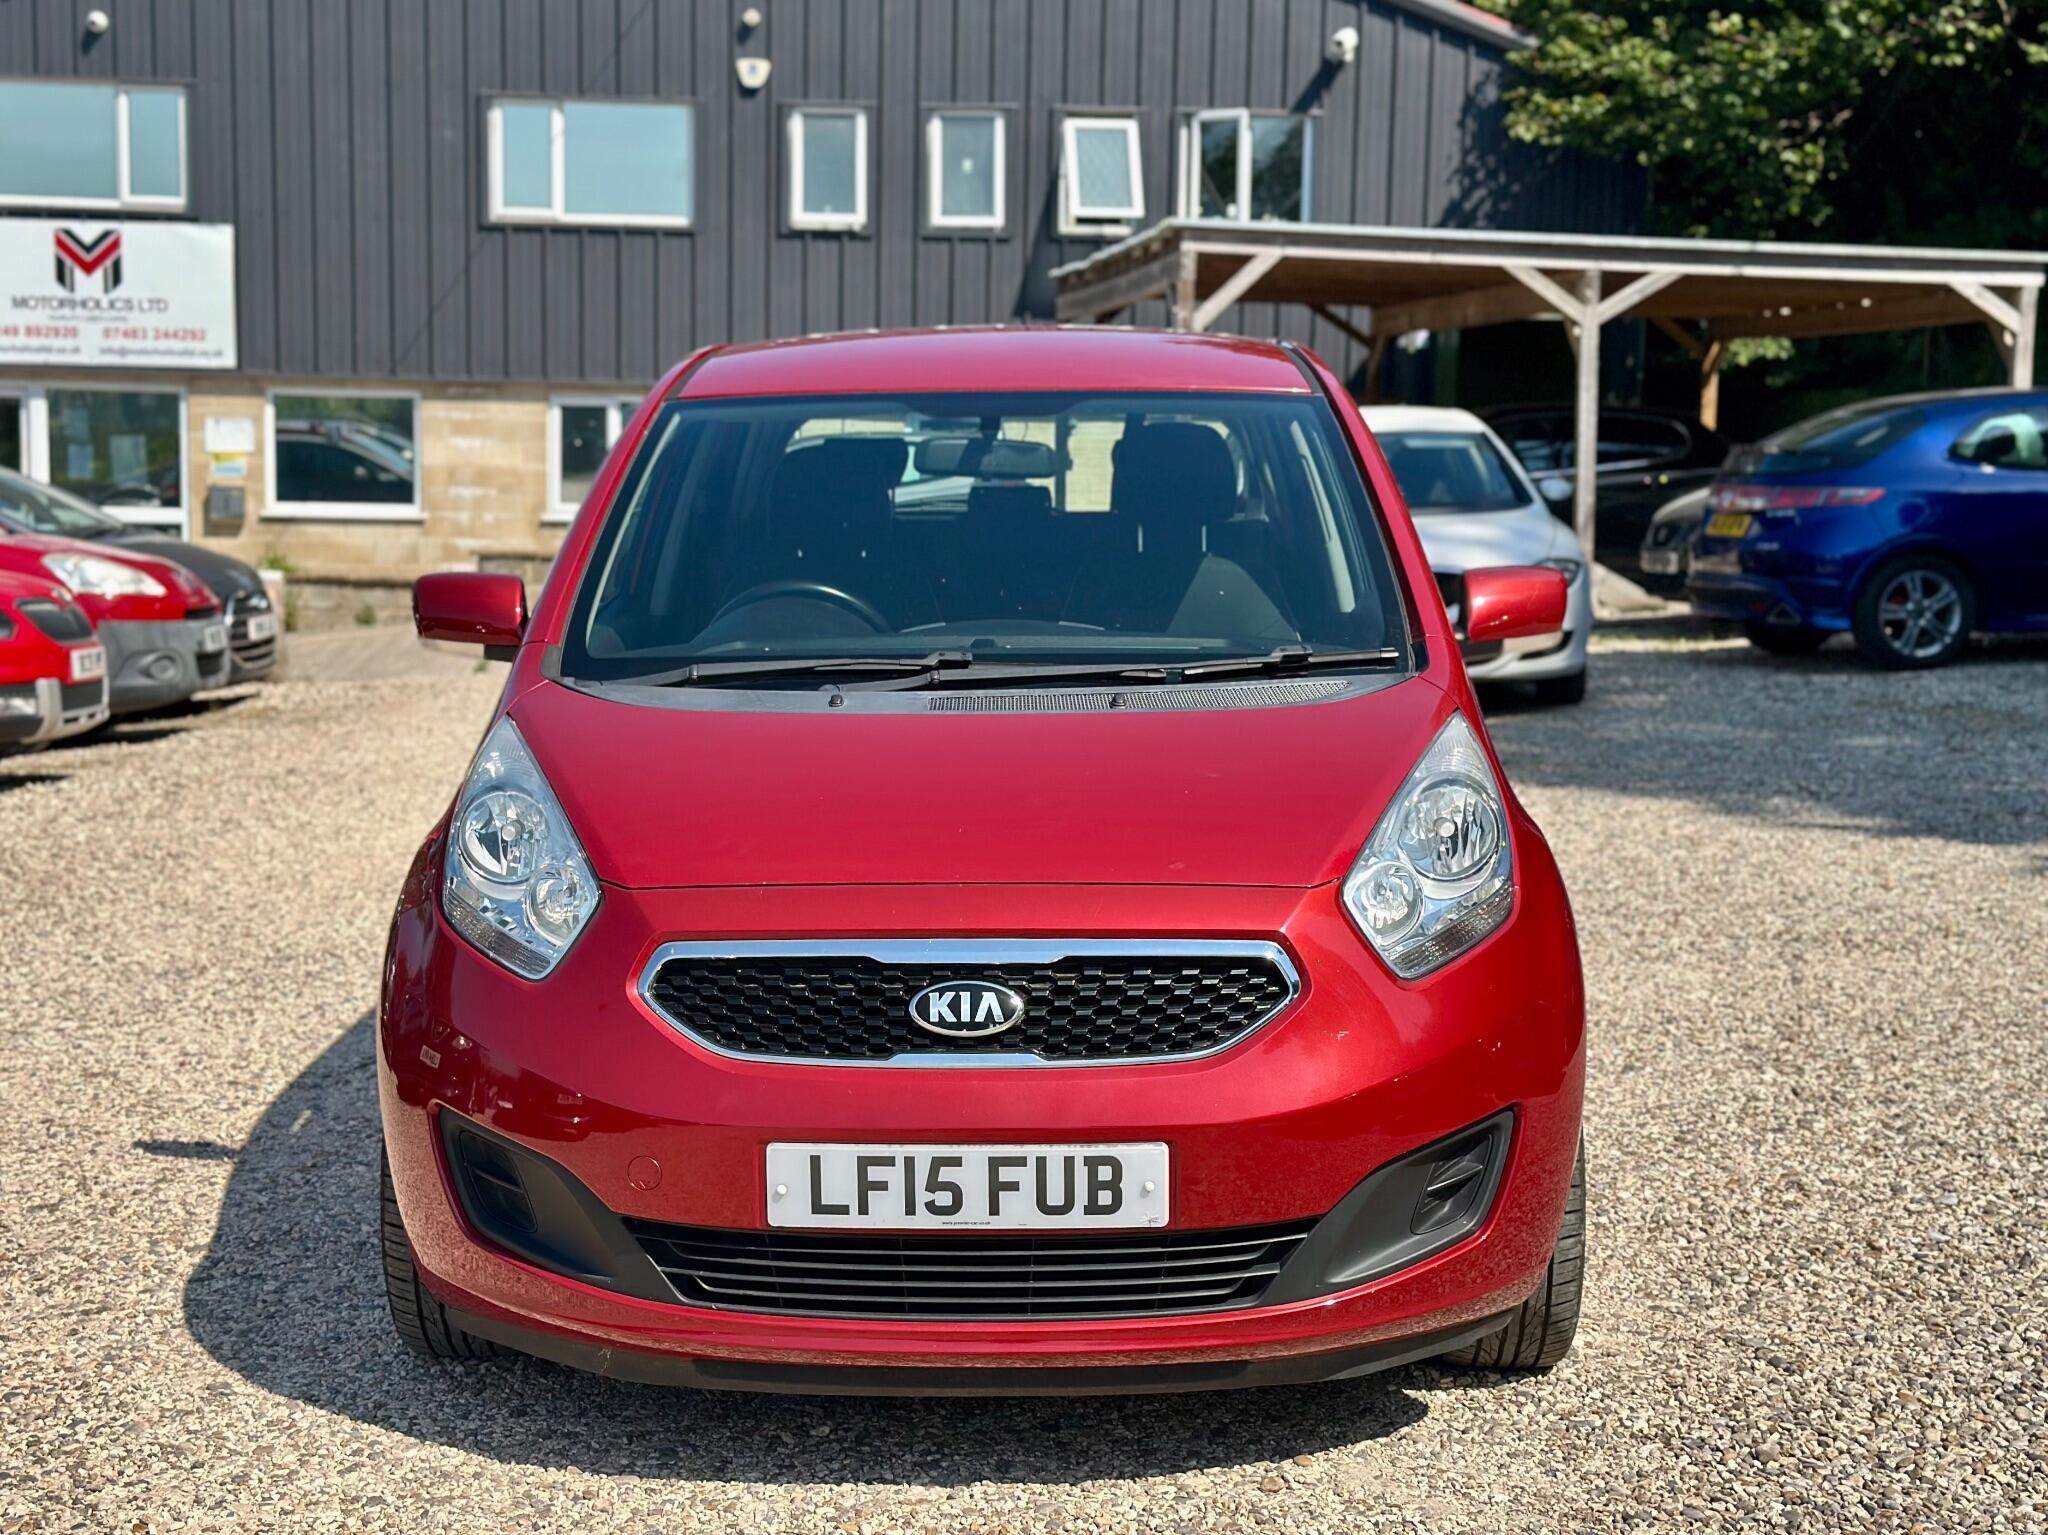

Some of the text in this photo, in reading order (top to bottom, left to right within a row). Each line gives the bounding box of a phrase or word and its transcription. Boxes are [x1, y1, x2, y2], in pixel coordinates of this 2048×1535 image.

[11, 296, 169, 313] MOTORHOLICS LTD
[928, 991, 1005, 1023] KIA
[809, 1154, 1124, 1217] LF15 FUB
